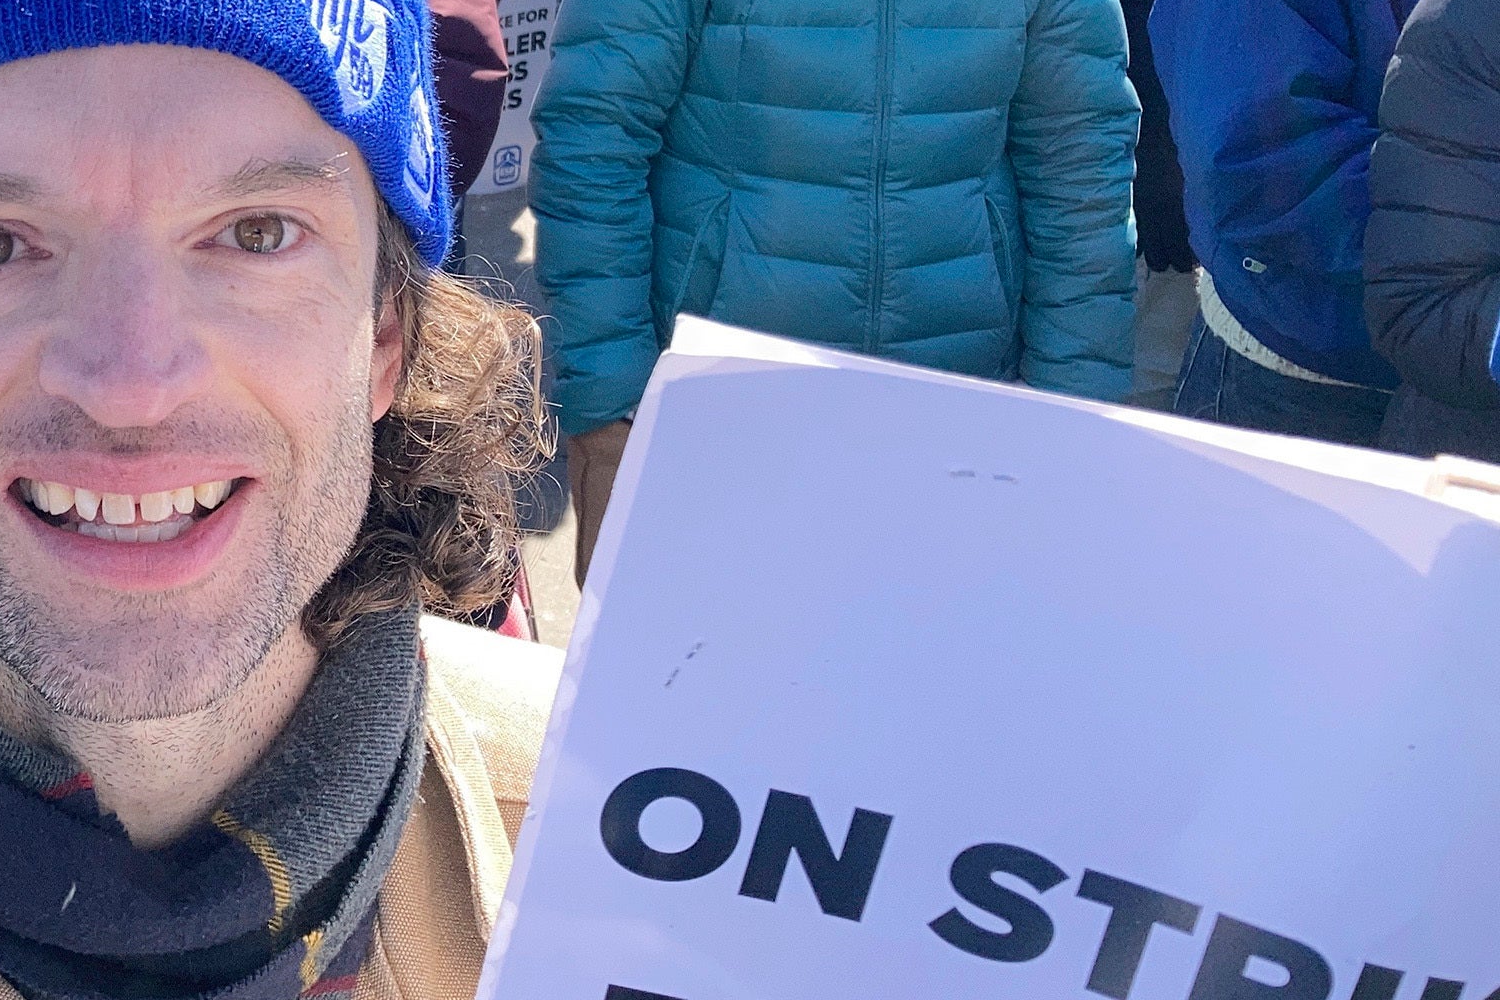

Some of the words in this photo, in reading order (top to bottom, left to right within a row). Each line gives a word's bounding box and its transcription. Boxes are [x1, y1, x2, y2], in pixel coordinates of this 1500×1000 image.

[518, 9, 547, 26] FOR
[600, 767, 894, 922] ON
[928, 842, 1500, 1000] STR
